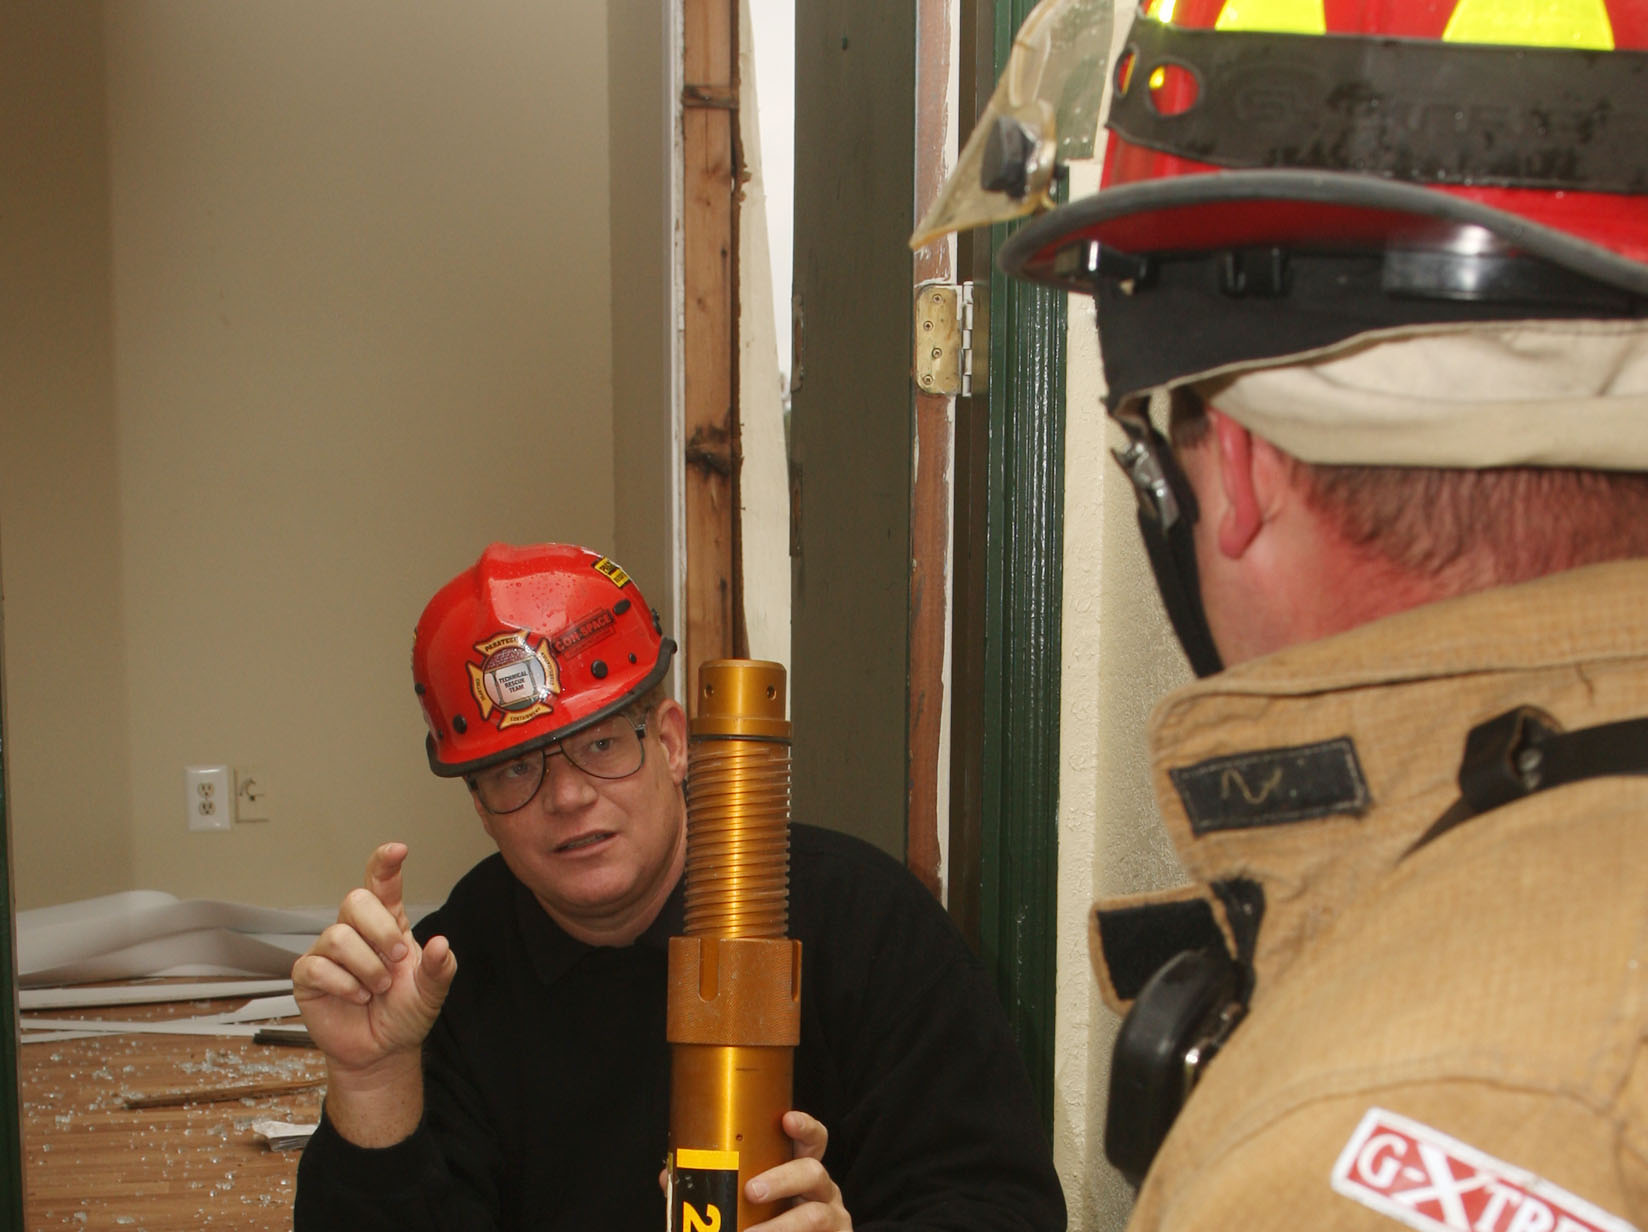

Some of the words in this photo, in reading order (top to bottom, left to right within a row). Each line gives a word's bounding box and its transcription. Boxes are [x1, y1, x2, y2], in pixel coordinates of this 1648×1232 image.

[498, 671, 528, 683] TECHNICAL
[504, 678, 524, 688] RESCUE
[509, 685, 524, 693] TEAM
